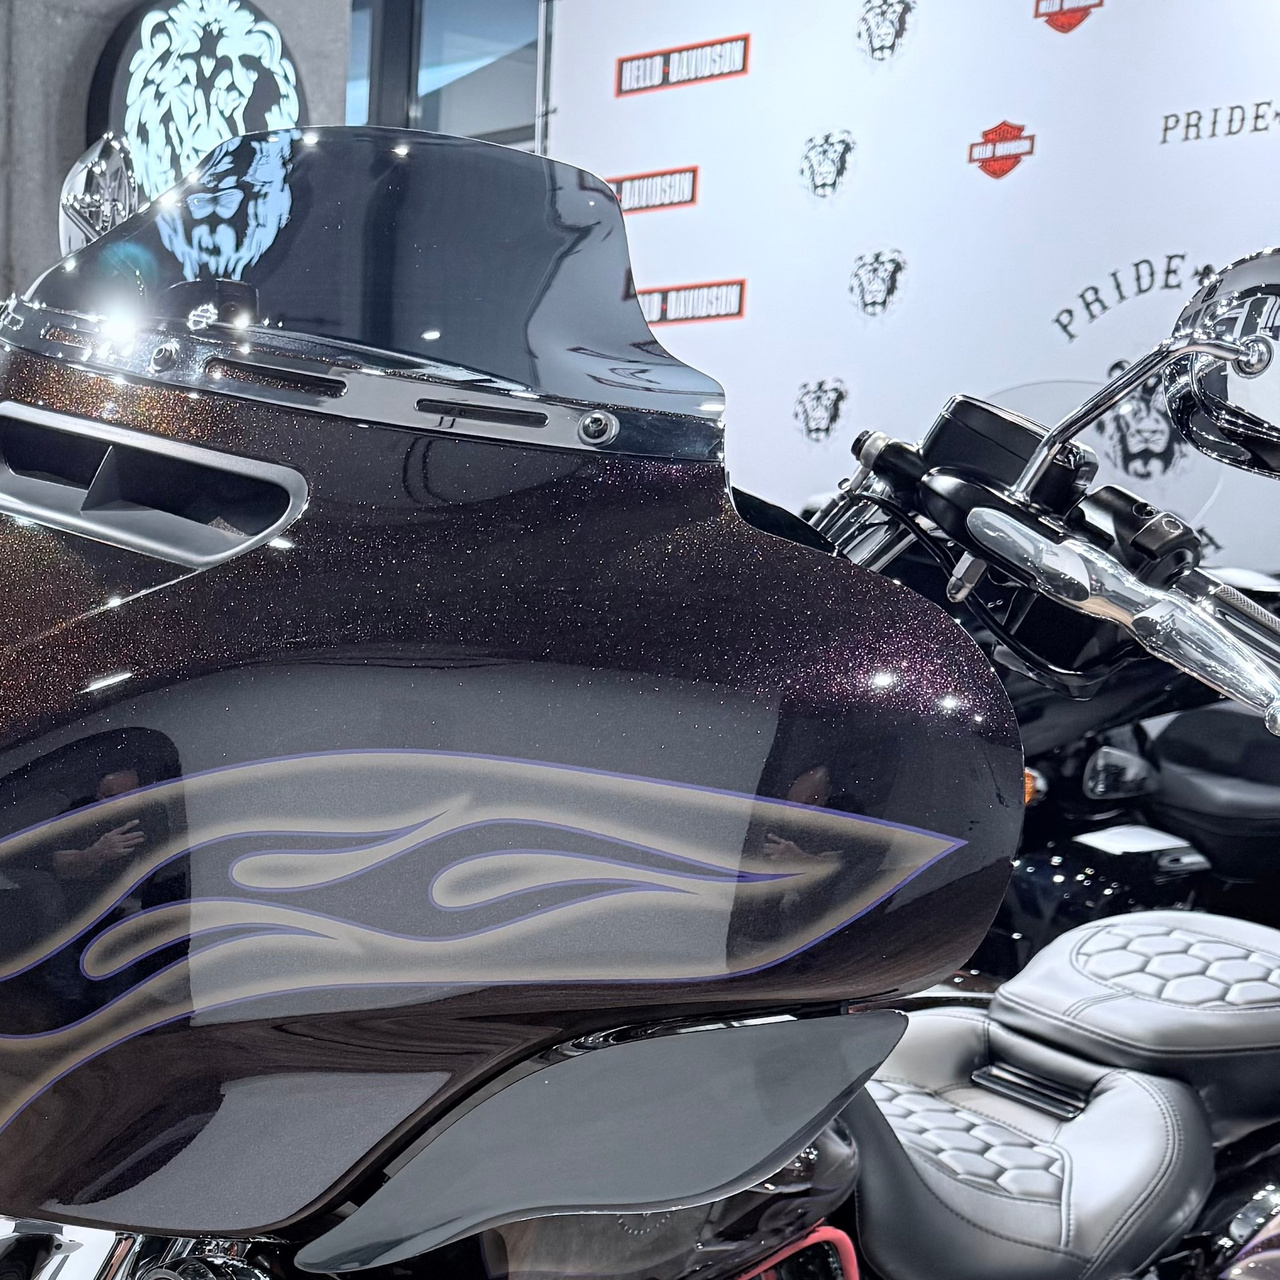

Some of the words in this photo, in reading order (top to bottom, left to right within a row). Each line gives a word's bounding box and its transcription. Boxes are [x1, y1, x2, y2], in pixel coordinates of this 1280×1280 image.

[668, 39, 746, 85] DAVIDSON
[1159, 99, 1273, 145] PRIDE
[666, 283, 742, 321] DAVIDSON
[1051, 251, 1188, 344] PRIDE
